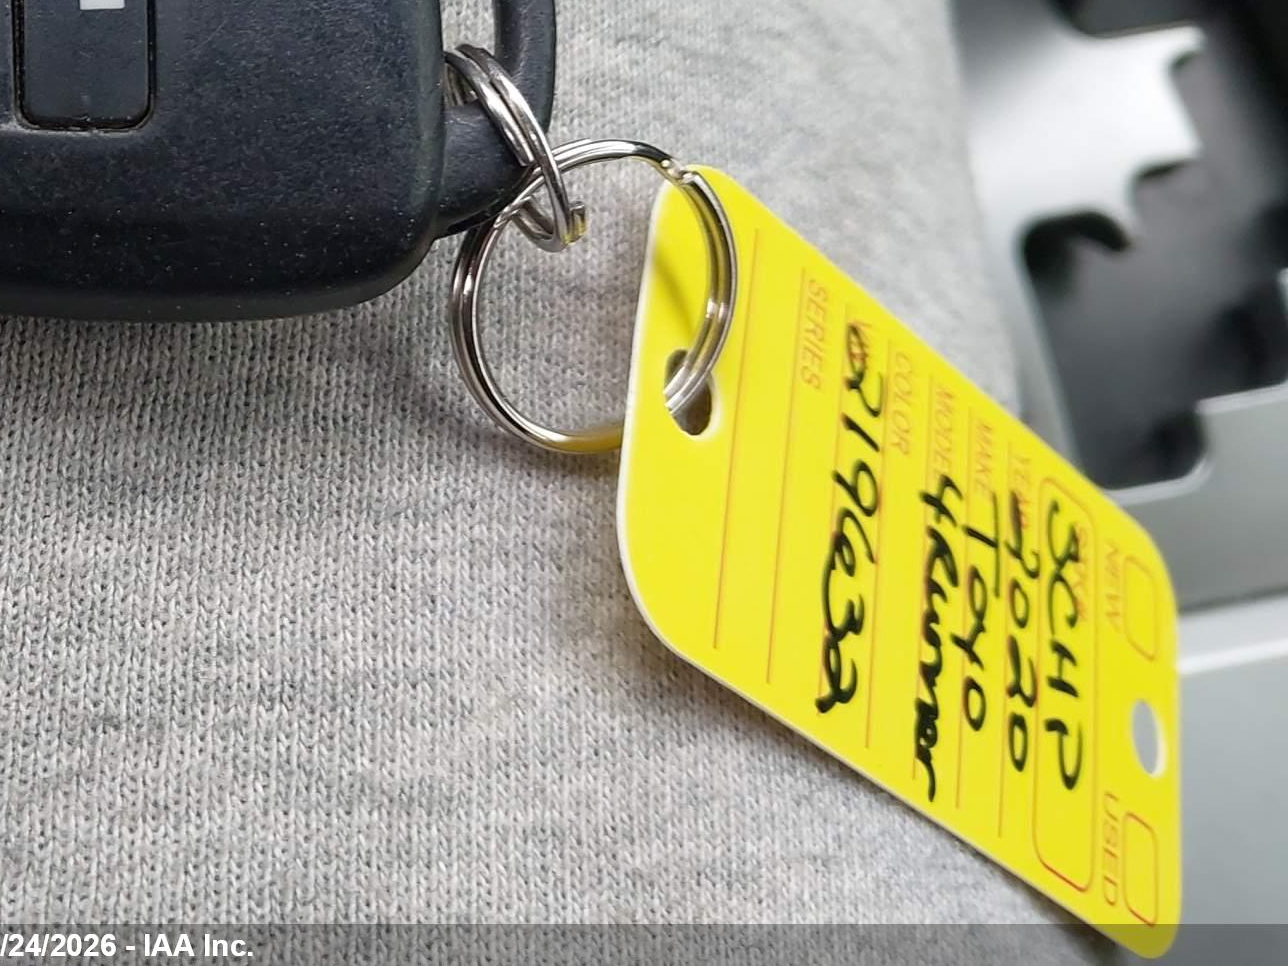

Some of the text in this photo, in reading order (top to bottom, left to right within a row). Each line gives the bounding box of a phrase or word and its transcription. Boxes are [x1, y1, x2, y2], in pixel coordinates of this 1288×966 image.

[800, 278, 831, 392] SERIES
[889, 351, 914, 457] COLOR
[973, 418, 994, 499] MAKE
[1004, 490, 1041, 772] 2020
[1104, 537, 1122, 632] NEW
[1102, 790, 1120, 907] USED
